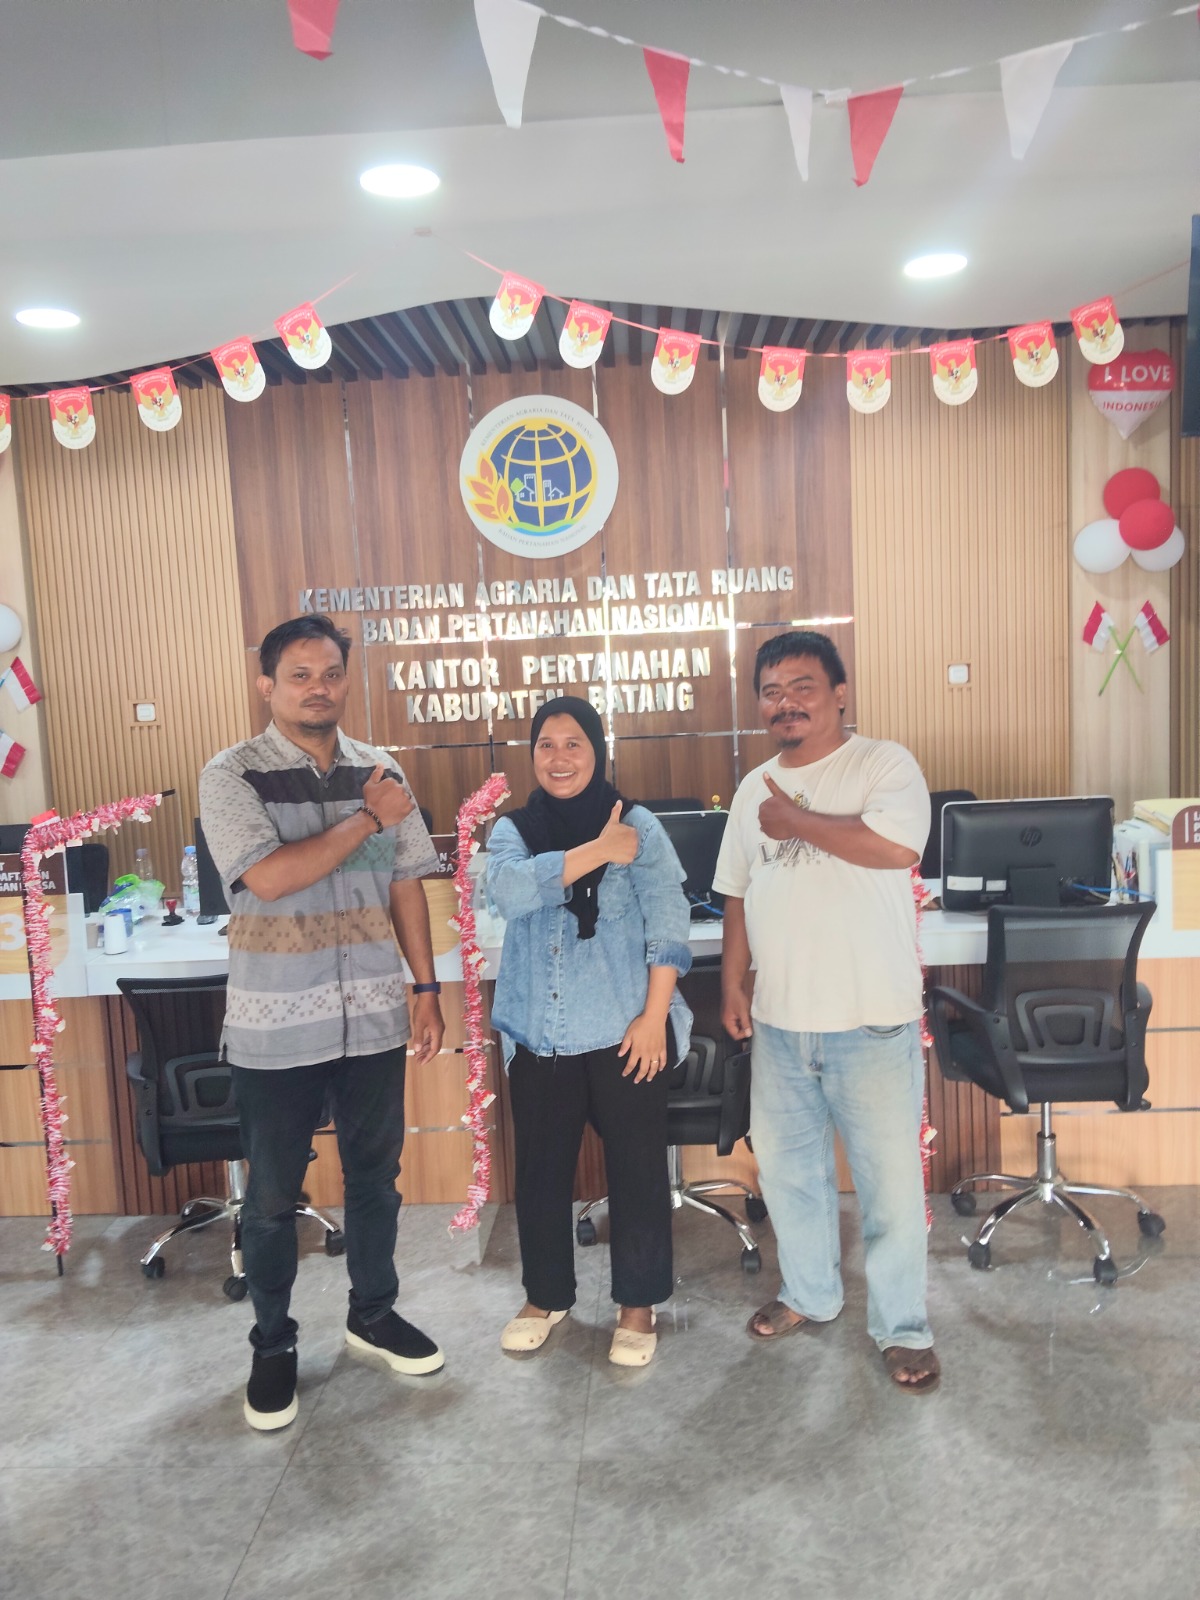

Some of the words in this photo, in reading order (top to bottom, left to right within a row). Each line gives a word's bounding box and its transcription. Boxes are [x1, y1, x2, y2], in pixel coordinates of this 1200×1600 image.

[1121, 365, 1170, 382] LOVE
[481, 413, 515, 446] KEMENTERIAN
[516, 407, 543, 417] AGRARIA
[544, 407, 558, 415] DAN
[576, 421, 593, 440] RUANG
[299, 582, 464, 613] KEMENTERIAN
[474, 577, 578, 606] AGRARIA
[587, 574, 636, 601] DAN
[644, 571, 702, 599] TATA
[711, 566, 794, 595] RUANG
[363, 614, 440, 642] BADAN
[448, 607, 602, 641] PERTANAHAN
[611, 600, 729, 632] NASIONAL
[387, 655, 500, 690] KANTOR
[522, 647, 711, 685] PERTANAHAN
[588, 681, 694, 716] BATANG
